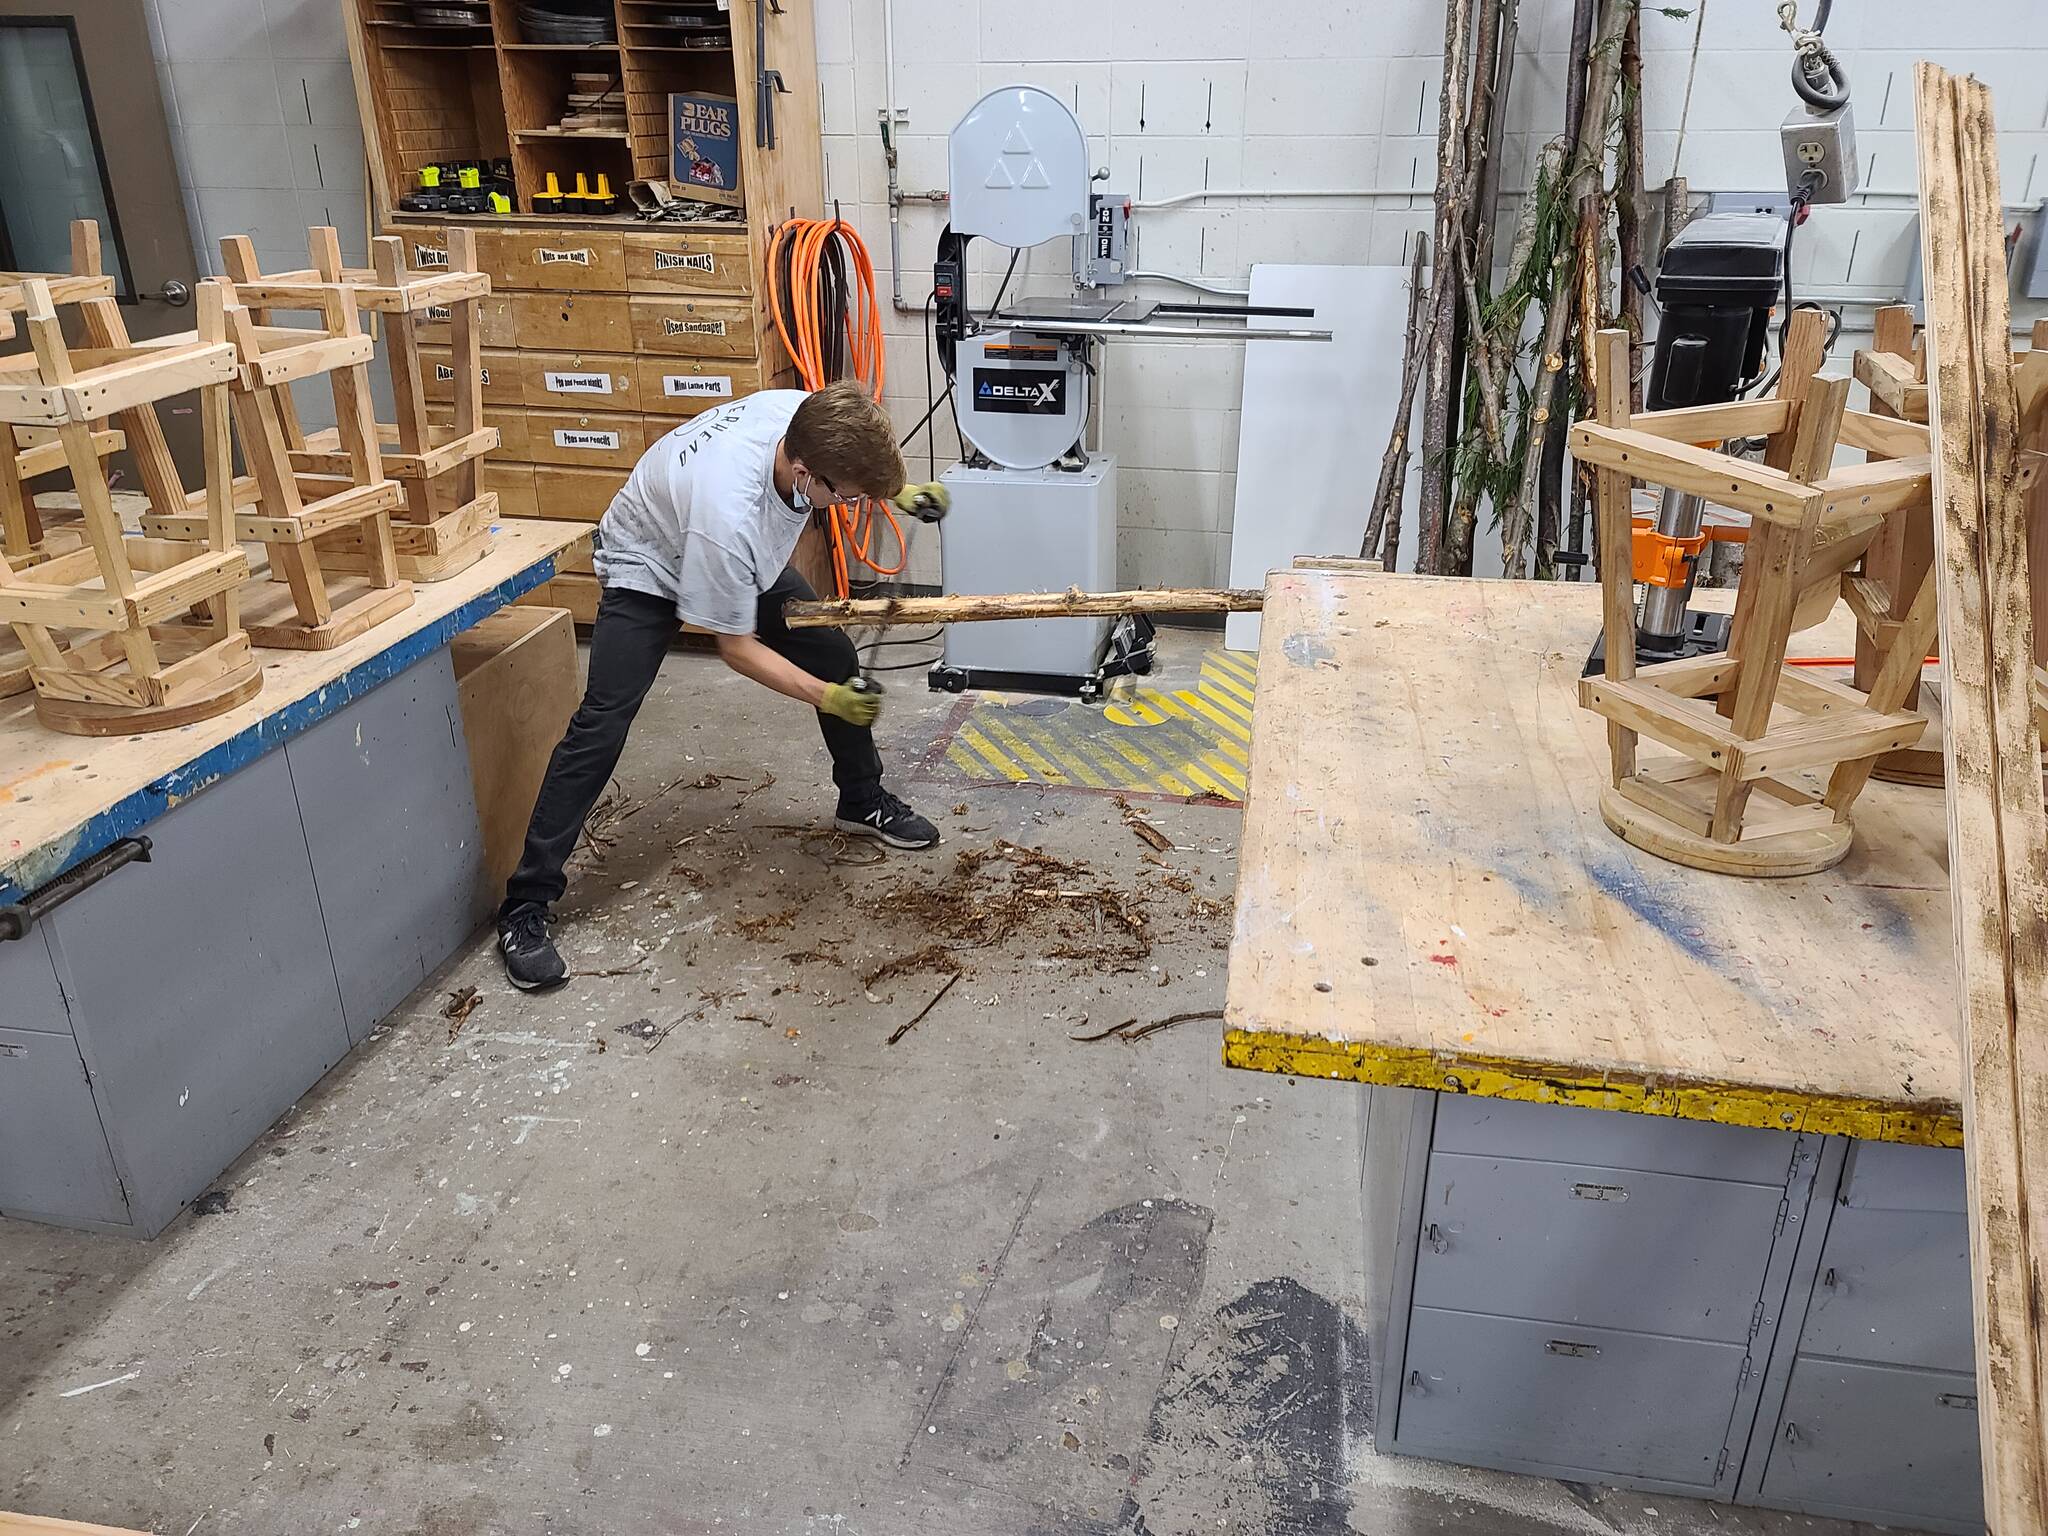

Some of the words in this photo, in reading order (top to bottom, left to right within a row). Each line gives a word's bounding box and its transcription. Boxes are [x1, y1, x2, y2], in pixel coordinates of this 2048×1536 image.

[696, 103, 728, 122] EAR
[680, 117, 731, 137] PLUGS
[1102, 210, 1110, 222] ON
[415, 244, 437, 267] Twist
[437, 251, 448, 264] Dri
[541, 250, 555, 261] Nuts
[655, 252, 684, 269] FINISH
[686, 254, 712, 272] NAILS
[428, 306, 450, 318] Wood
[666, 319, 683, 334] Used
[684, 322, 722, 334] Sandpaper
[705, 381, 721, 392] Parts
[993, 385, 1040, 397] DELTA
[564, 432, 577, 444] Pens
[590, 434, 611, 446] Pencils
[679, 399, 748, 468] ERHEAD
